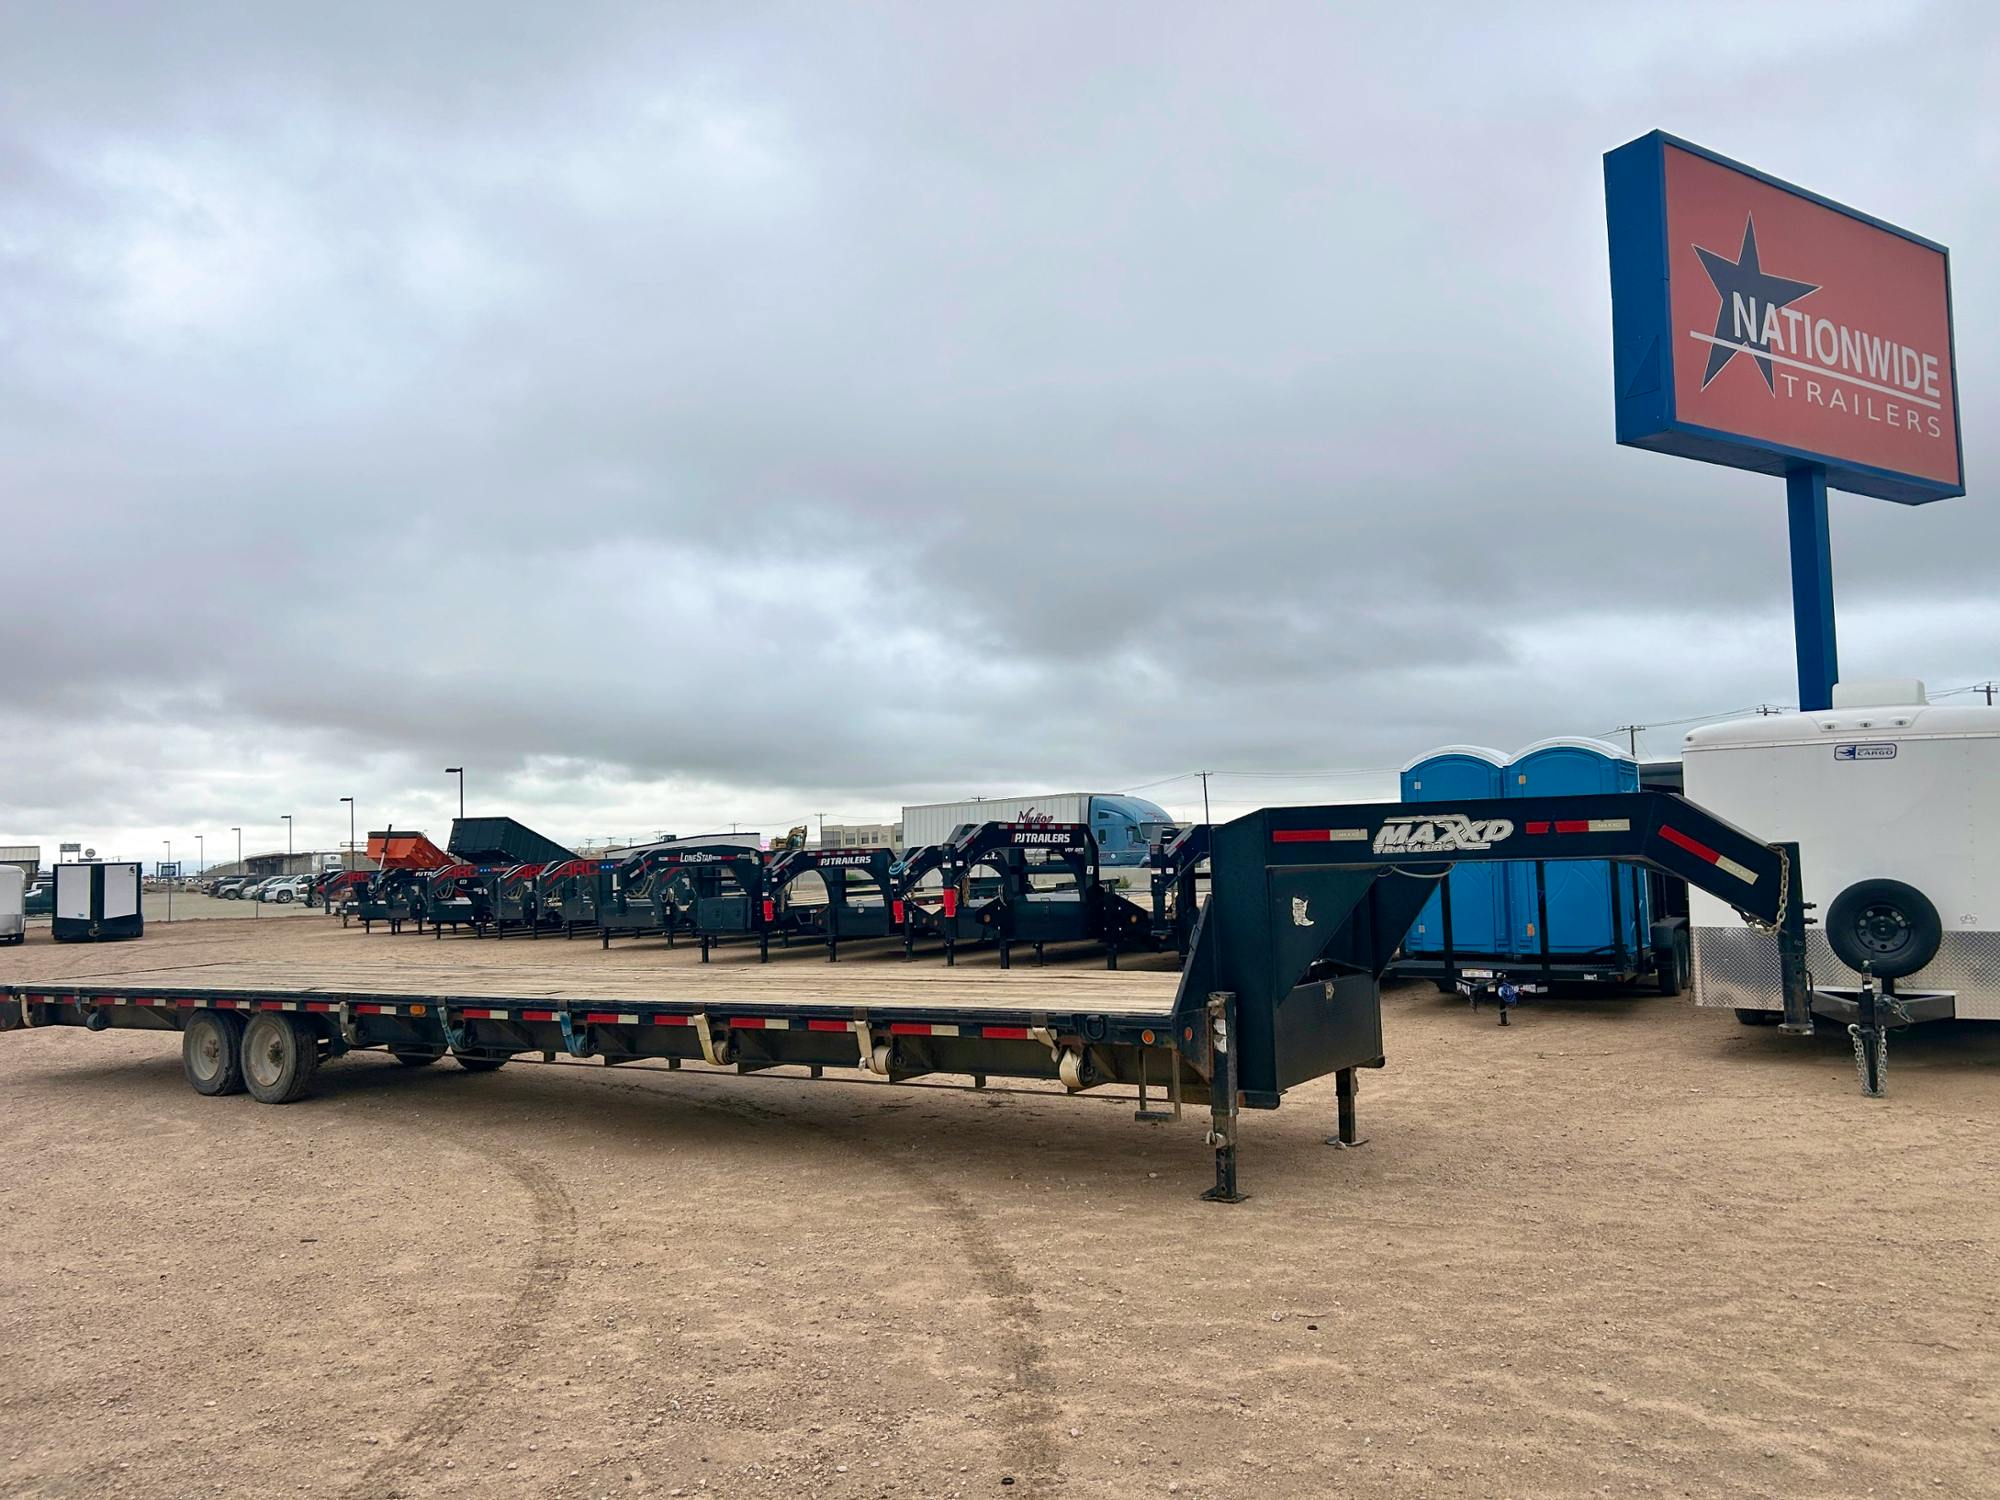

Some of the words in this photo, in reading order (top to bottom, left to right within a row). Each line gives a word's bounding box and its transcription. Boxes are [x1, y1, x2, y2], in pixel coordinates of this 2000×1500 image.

[1732, 291, 1940, 399] NATIONWIDE
[1780, 373, 1942, 438] TRAILERS
[1373, 843, 1457, 854] TRAILERS
